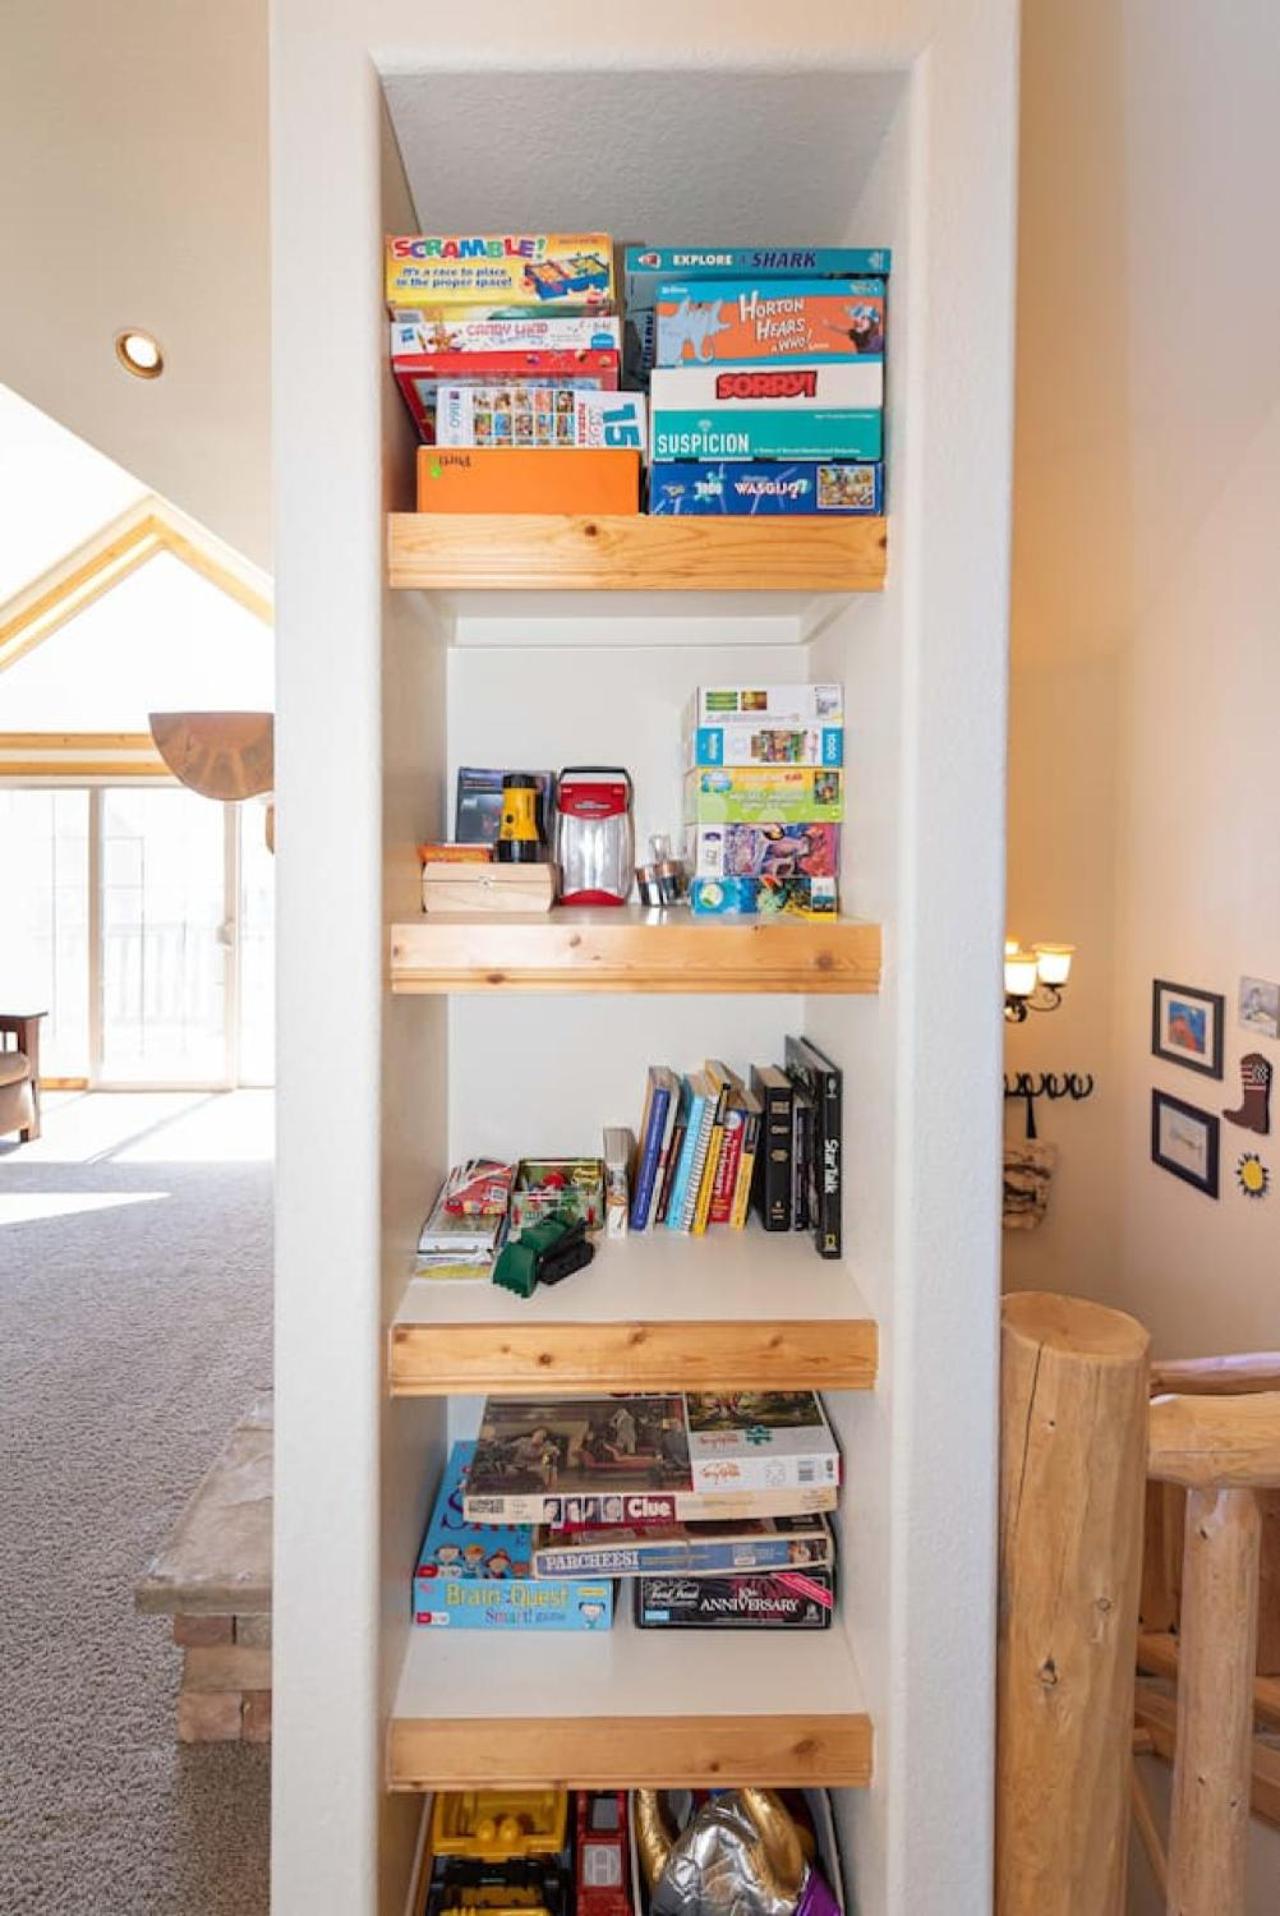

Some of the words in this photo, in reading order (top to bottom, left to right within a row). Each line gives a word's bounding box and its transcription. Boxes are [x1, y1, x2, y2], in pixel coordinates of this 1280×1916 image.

[394, 238, 546, 259] SCRAMBLE!
[673, 254, 732, 266] EXPLORE
[751, 252, 816, 267] SHARK
[466, 324, 511, 336] CANDY
[515, 322, 548, 335] LAND
[757, 318, 806, 341] HEARS
[716, 371, 817, 399] SORRY!
[603, 403, 640, 447] 15
[657, 433, 749, 454] SUSPICION
[824, 1139, 840, 1194] StarTalk
[628, 1499, 672, 1518] Clue
[545, 1550, 640, 1571] PARCHEESI
[446, 1584, 501, 1606] Brain
[510, 1584, 568, 1607] Quest
[700, 1598, 799, 1612] ANNIVERSARY
